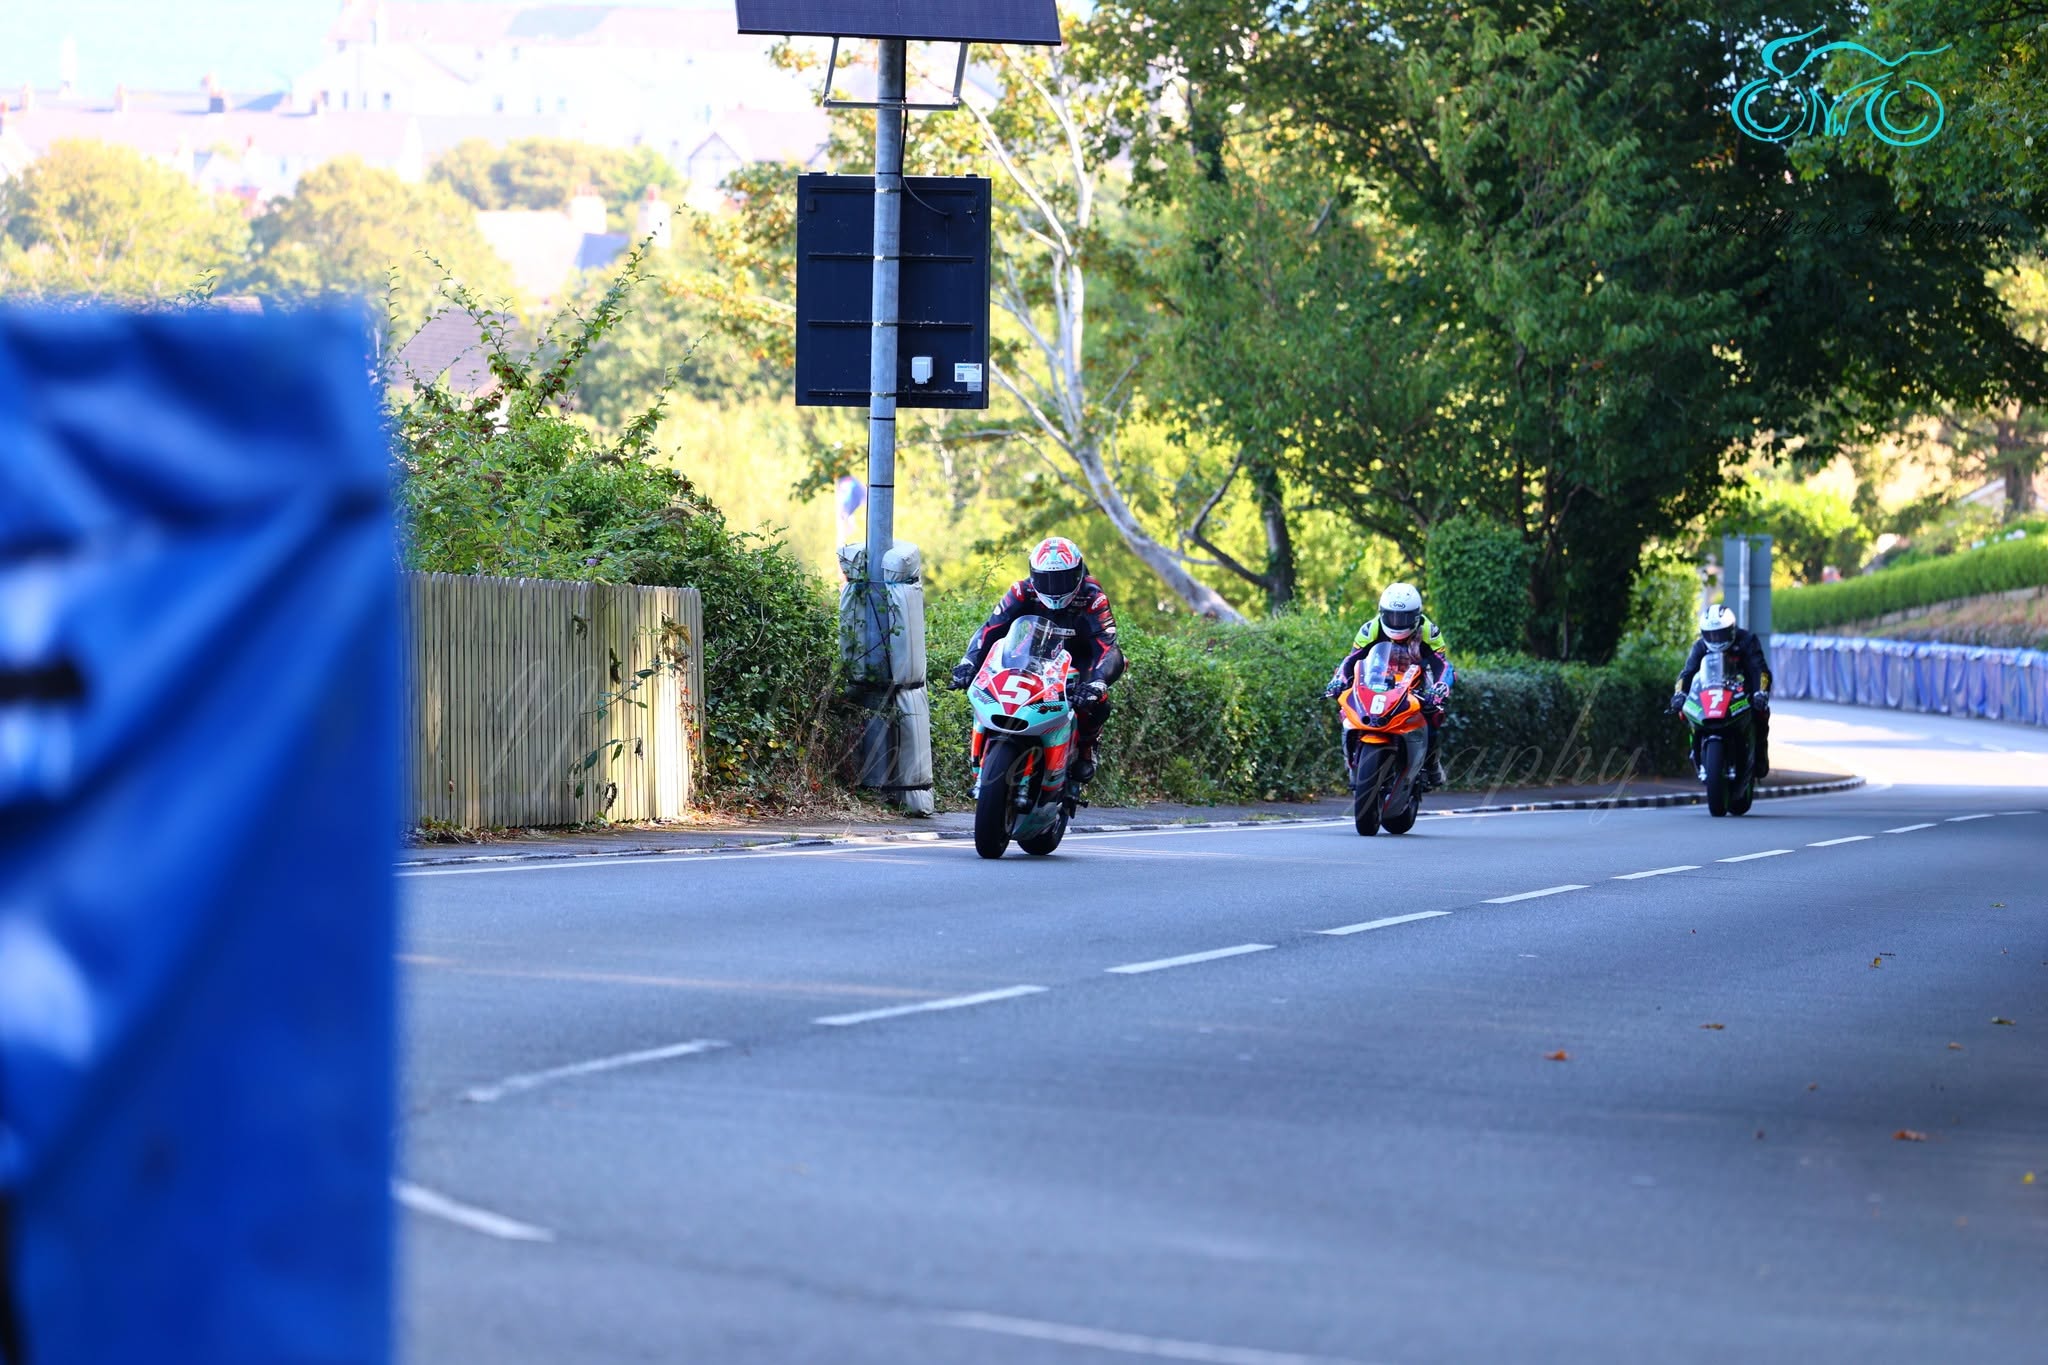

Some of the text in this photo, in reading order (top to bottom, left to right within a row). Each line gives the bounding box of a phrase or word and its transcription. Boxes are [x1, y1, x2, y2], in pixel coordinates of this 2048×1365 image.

[1000, 674, 1036, 705] 5
[1708, 688, 1723, 709] 7
[1370, 694, 1386, 715] 6
